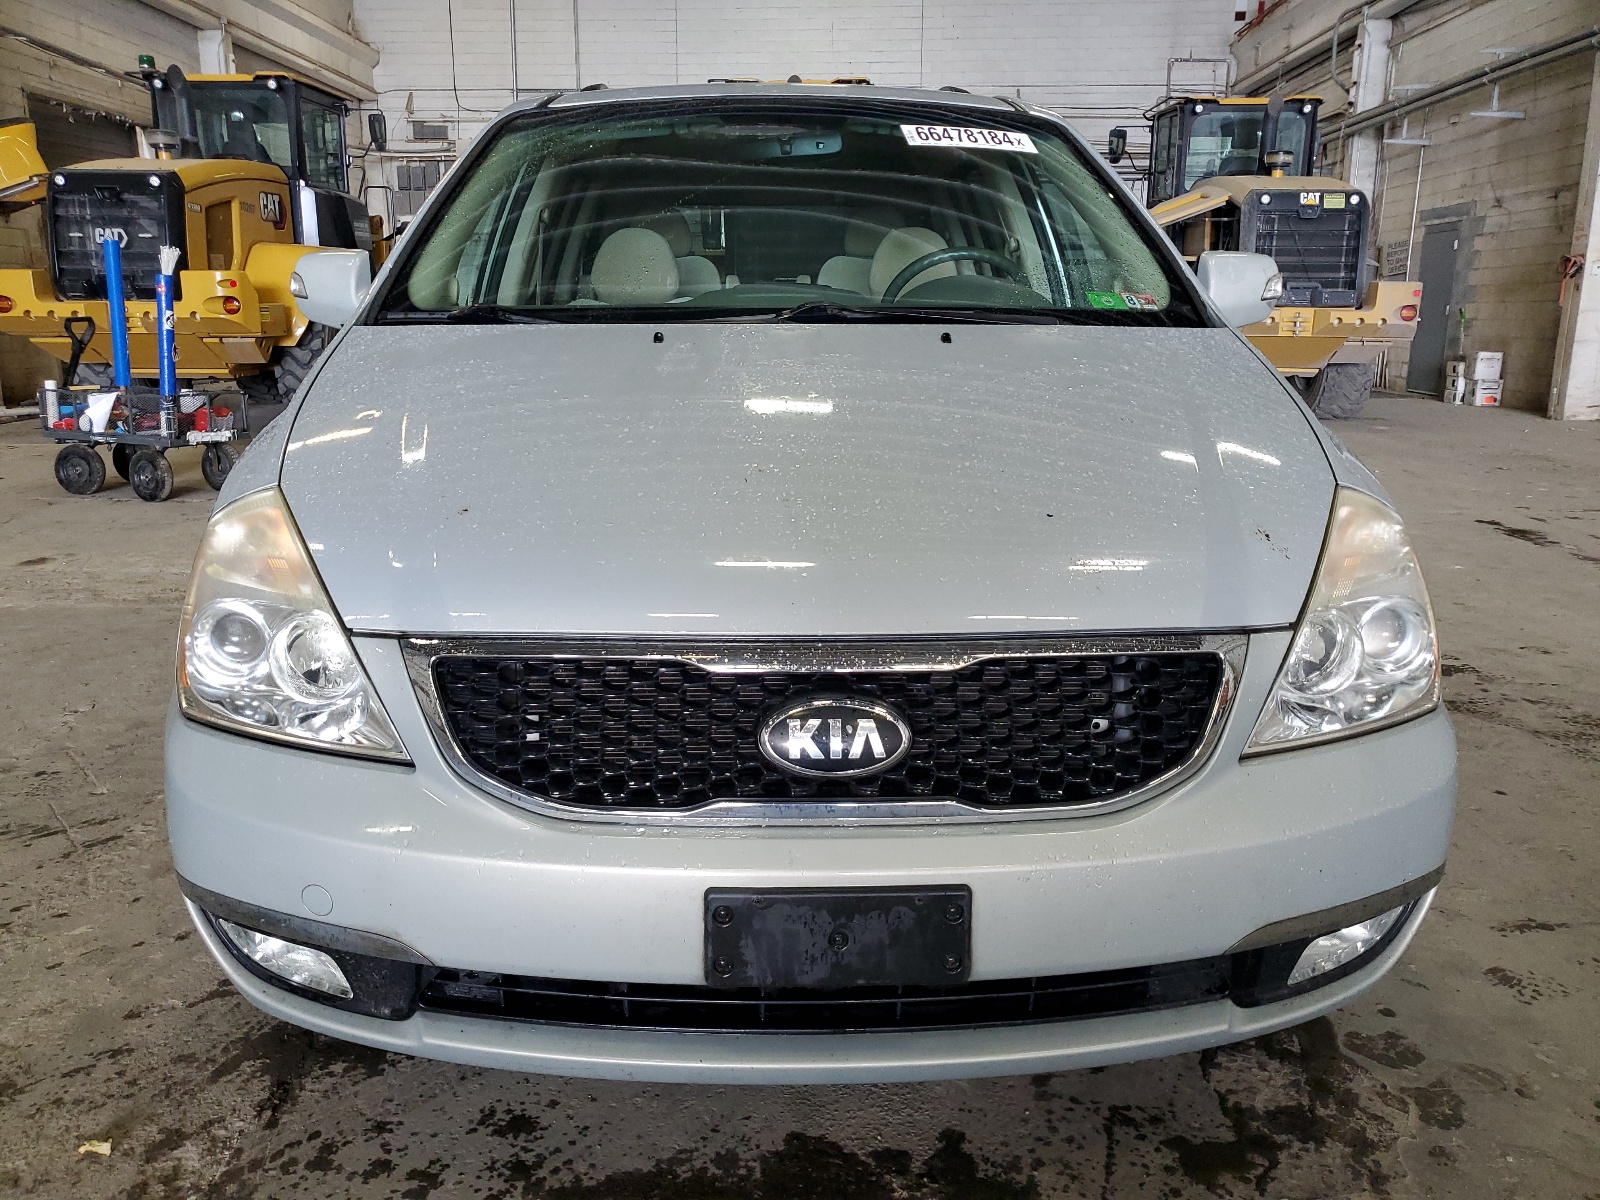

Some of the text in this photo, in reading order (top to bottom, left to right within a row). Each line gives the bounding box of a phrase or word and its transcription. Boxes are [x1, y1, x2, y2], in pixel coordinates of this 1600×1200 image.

[1300, 192, 1321, 205] CAT
[260, 192, 280, 221] CAT
[95, 228, 120, 243] CAT
[1387, 240, 1409, 250] PLEASE
[1386, 249, 1408, 258] REPORT
[1387, 264, 1407, 273] OFFICE
[1126, 295, 1137, 306] 8
[786, 718, 887, 760] KIA
